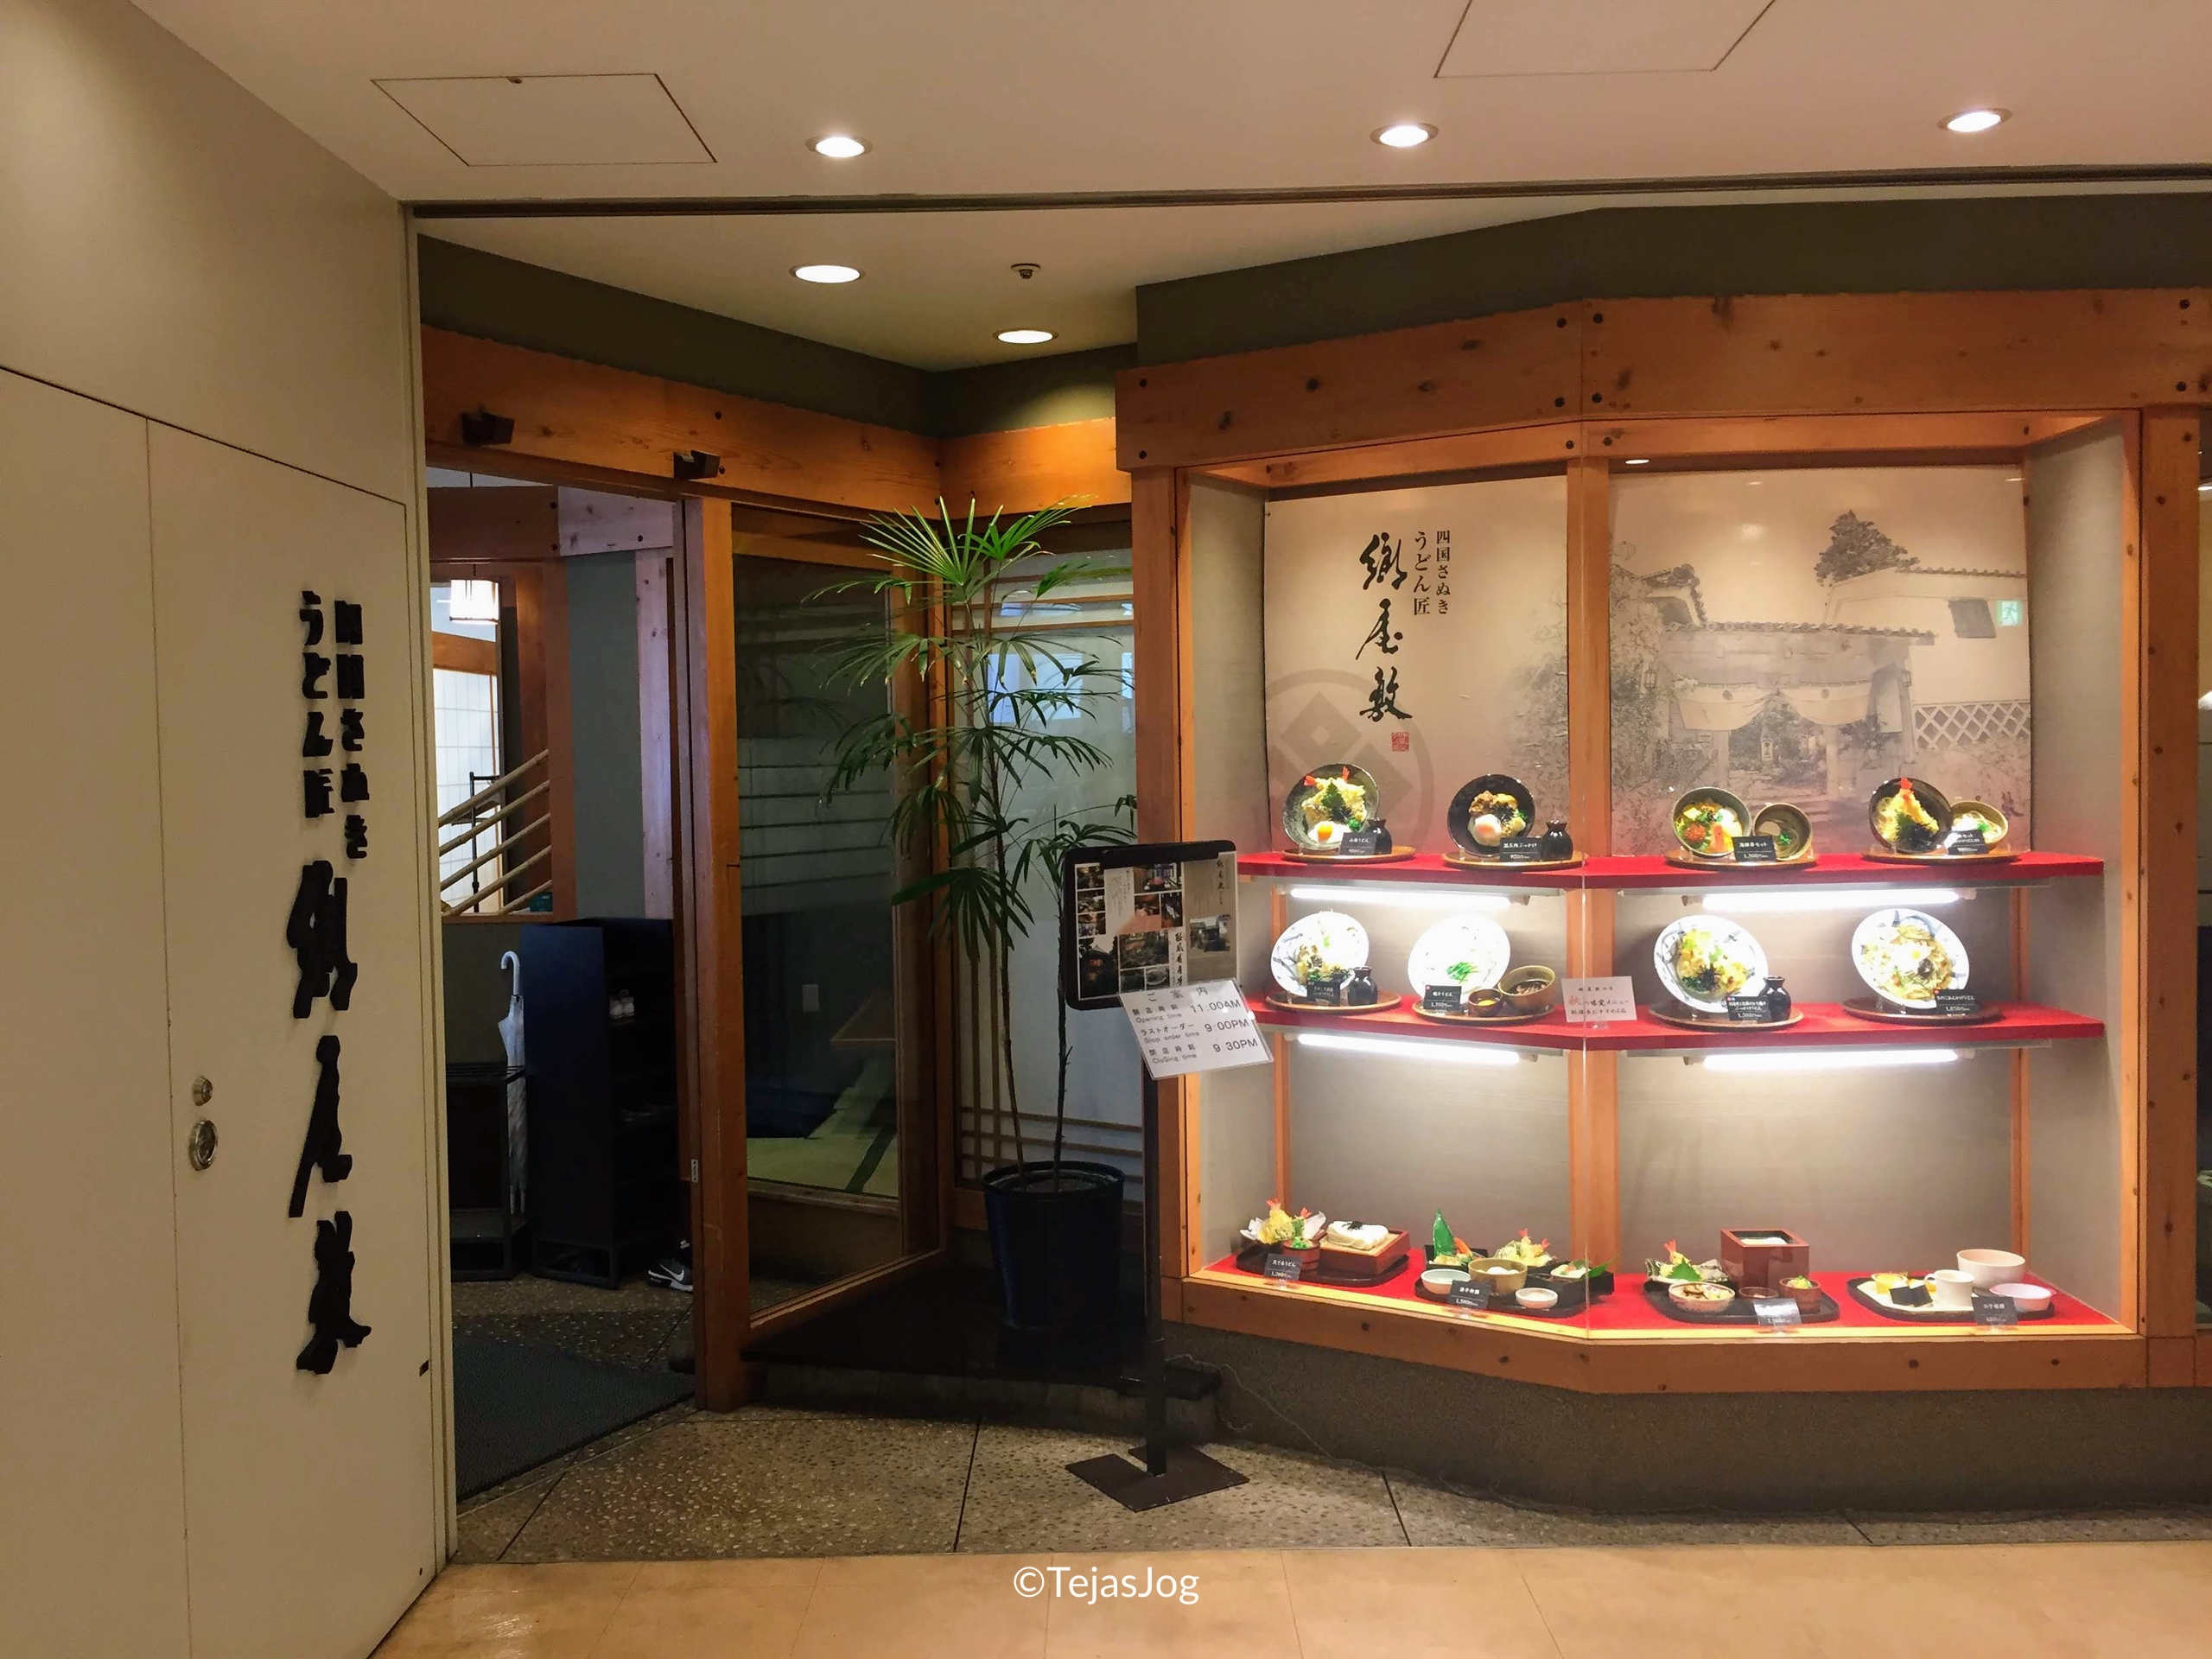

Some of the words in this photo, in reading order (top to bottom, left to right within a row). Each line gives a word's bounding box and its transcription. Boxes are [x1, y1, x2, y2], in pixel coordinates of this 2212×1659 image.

[1414, 531, 1432, 616] うどん匠
[1436, 530, 1451, 614] 四国さぬき
[1135, 1015, 1164, 1024] Opening
[1141, 1023, 1194, 1036] ラストオーダー
